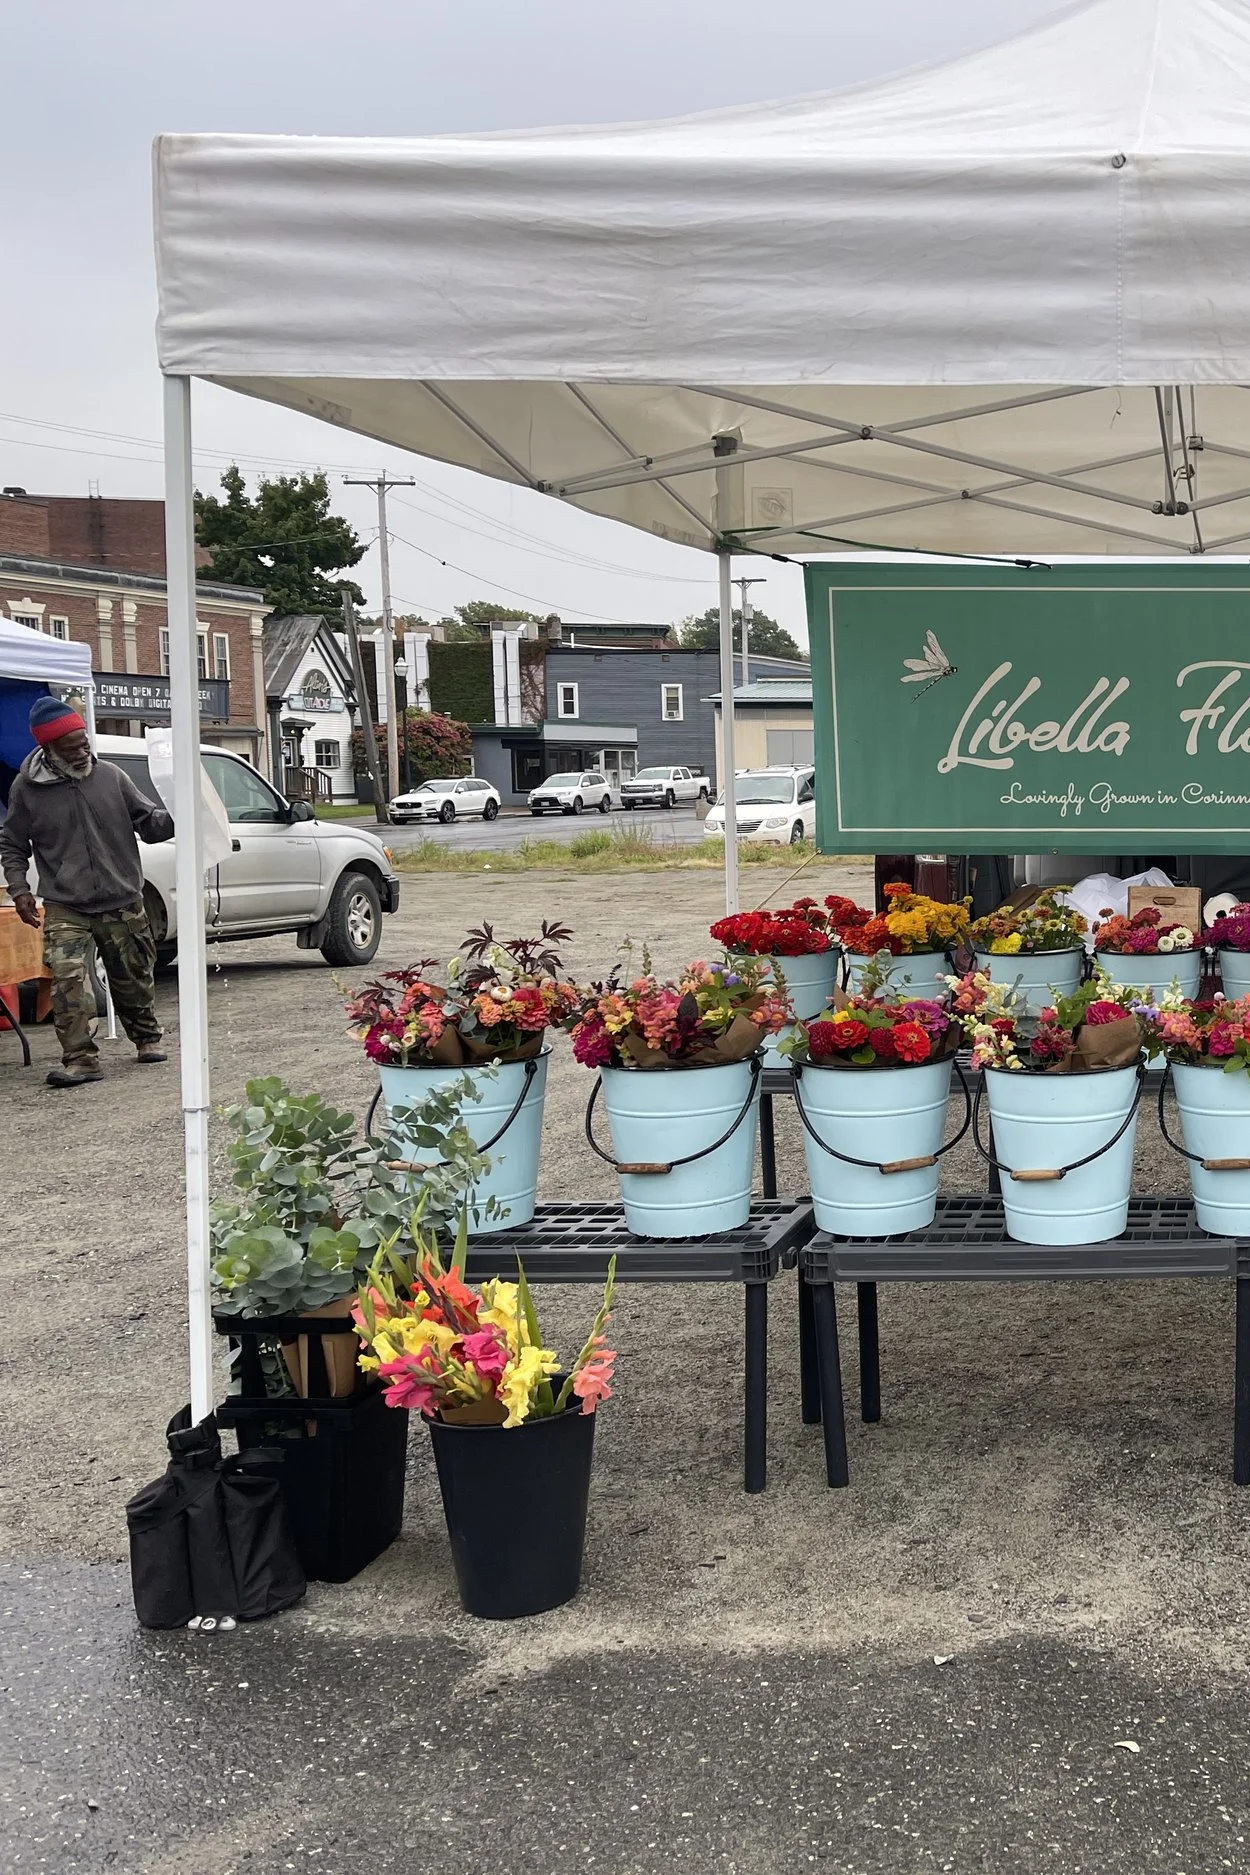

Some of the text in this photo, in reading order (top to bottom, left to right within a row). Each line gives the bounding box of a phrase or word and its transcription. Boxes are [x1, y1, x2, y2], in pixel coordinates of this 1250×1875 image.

[101, 684, 128, 696] CINEMA
[132, 686, 152, 697] OPEN
[155, 688, 161, 698] 7
[198, 690, 212, 701] EEK
[110, 697, 117, 706] &
[120, 697, 144, 708] DOLBY
[148, 699, 171, 709] DIGITA
[937, 661, 1131, 774] Libella
[1000, 782, 1085, 817] Lovingly
[1089, 782, 1154, 813] Grown
[1157, 790, 1178, 804] in
